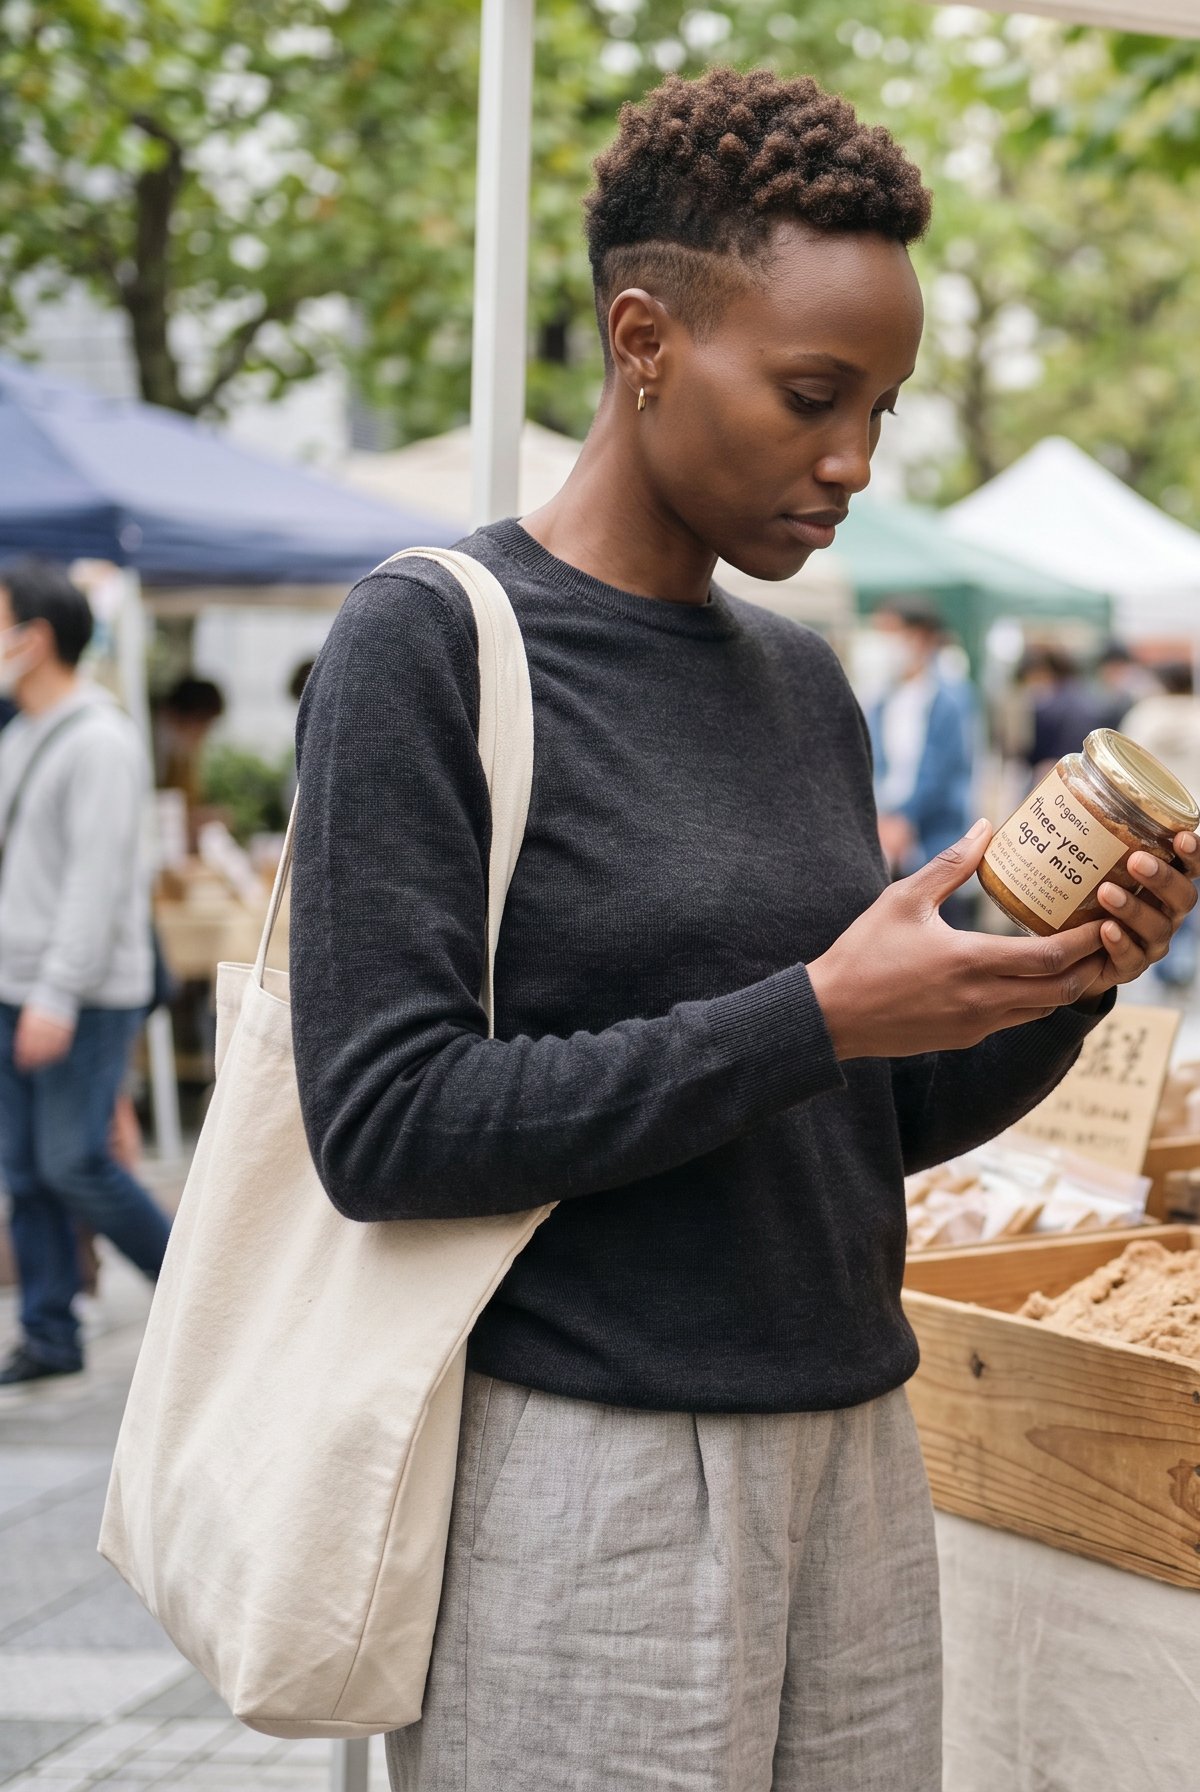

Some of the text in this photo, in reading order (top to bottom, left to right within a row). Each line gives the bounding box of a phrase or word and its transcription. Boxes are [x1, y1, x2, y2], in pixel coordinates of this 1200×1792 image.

[1029, 796, 1100, 871] three-year-
[1054, 795, 1090, 836] Organic
[1018, 821, 1051, 854] aged
[1049, 855, 1083, 885] miso
